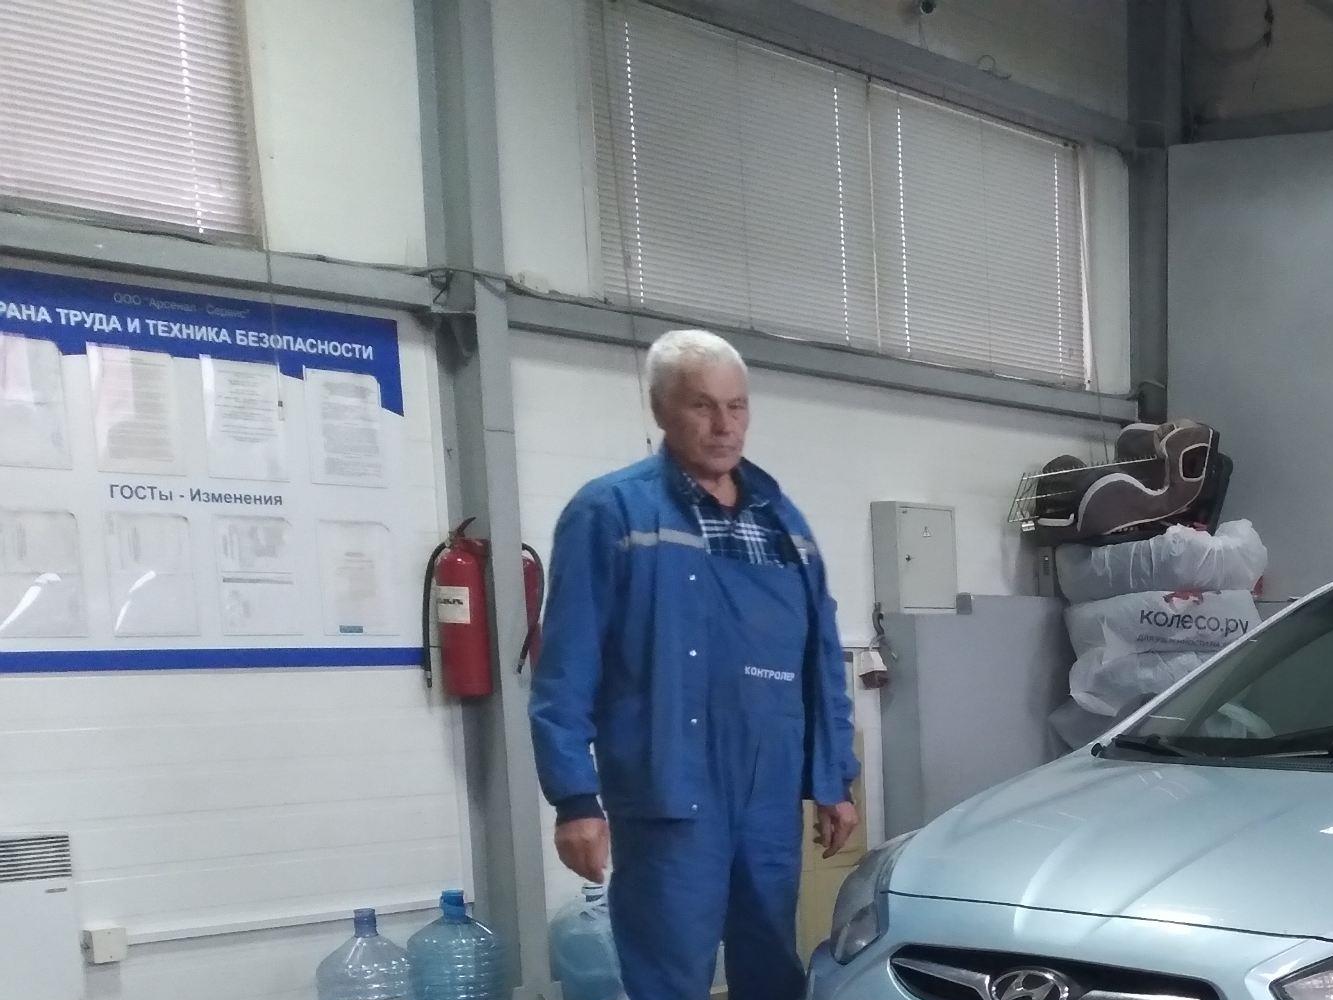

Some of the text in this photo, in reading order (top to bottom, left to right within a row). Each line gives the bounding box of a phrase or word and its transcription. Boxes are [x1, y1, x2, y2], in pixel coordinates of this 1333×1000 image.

[113, 292, 141, 306] ООО
[55, 308, 122, 333] ТРУДА
[126, 317, 141, 334] И
[145, 319, 232, 344] ТЕХНИКА
[235, 329, 374, 361] БЕЗОПАСНОСТИ
[109, 484, 173, 501] ГОСТы
[189, 488, 283, 506] Изменения
[744, 665, 796, 682] КОНТРОЛЕР
